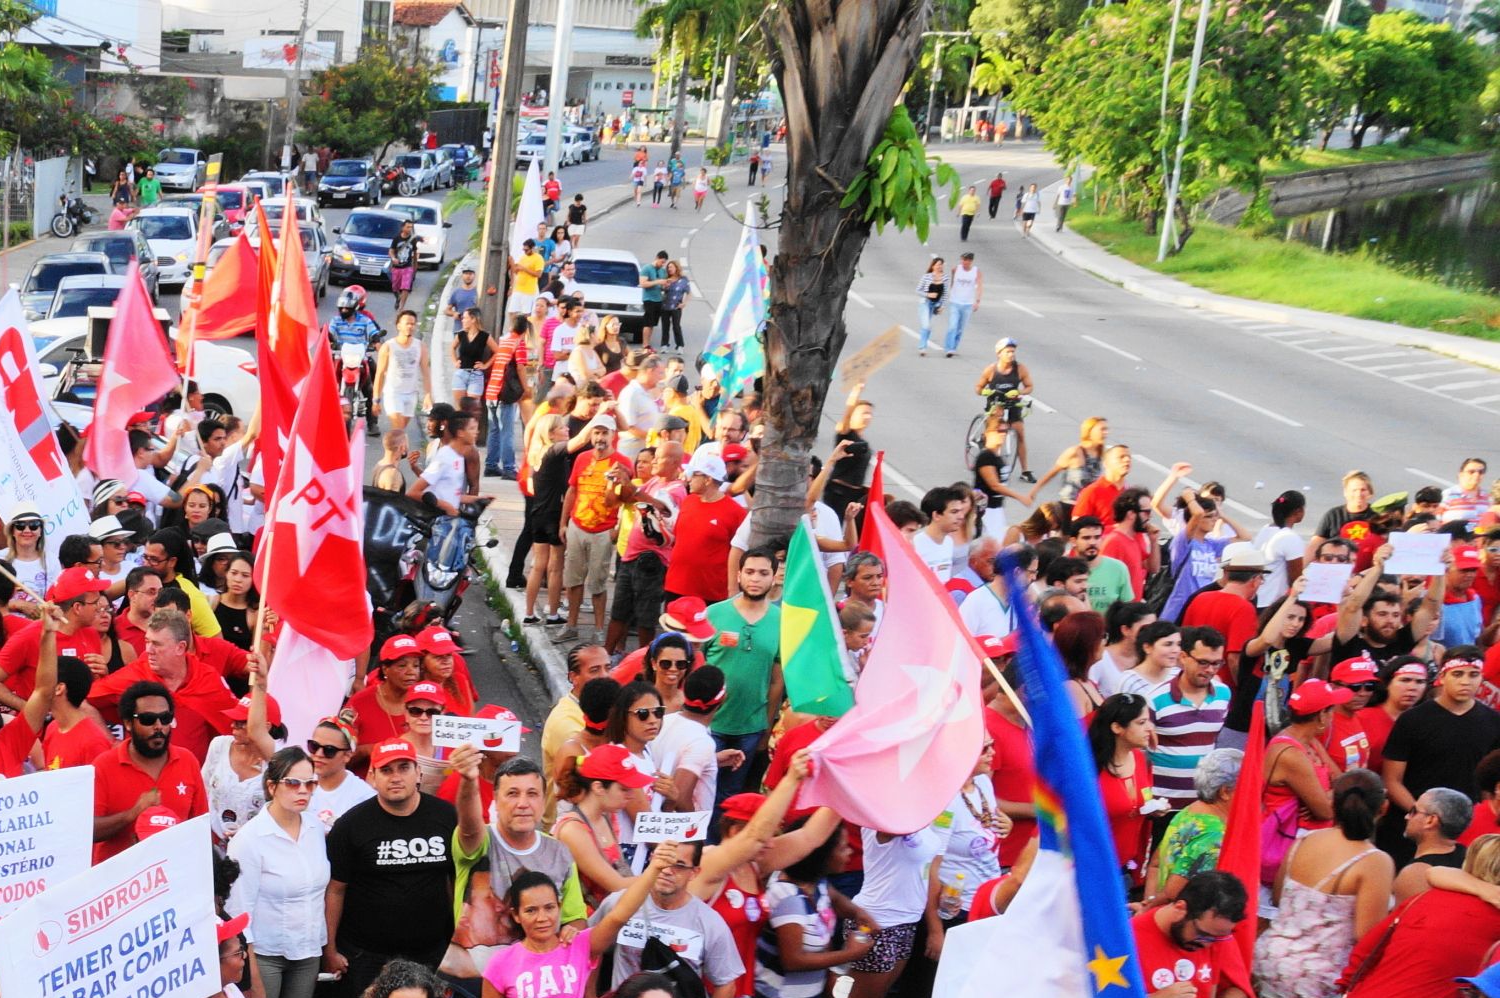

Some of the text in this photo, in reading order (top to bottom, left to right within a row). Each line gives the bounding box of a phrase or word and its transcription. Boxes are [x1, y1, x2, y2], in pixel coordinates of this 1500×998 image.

[291, 477, 346, 531] PT
[18, 790, 39, 807] AO
[150, 815, 175, 826] CUT
[650, 815, 661, 823] da
[377, 836, 445, 859] #SOS
[376, 855, 447, 866] EDUCAÇÃO PÚBLICA
[67, 866, 168, 934] SINPROJA
[38, 908, 177, 997] TEMER QUER
[123, 940, 169, 982] COM
[179, 927, 195, 951] A
